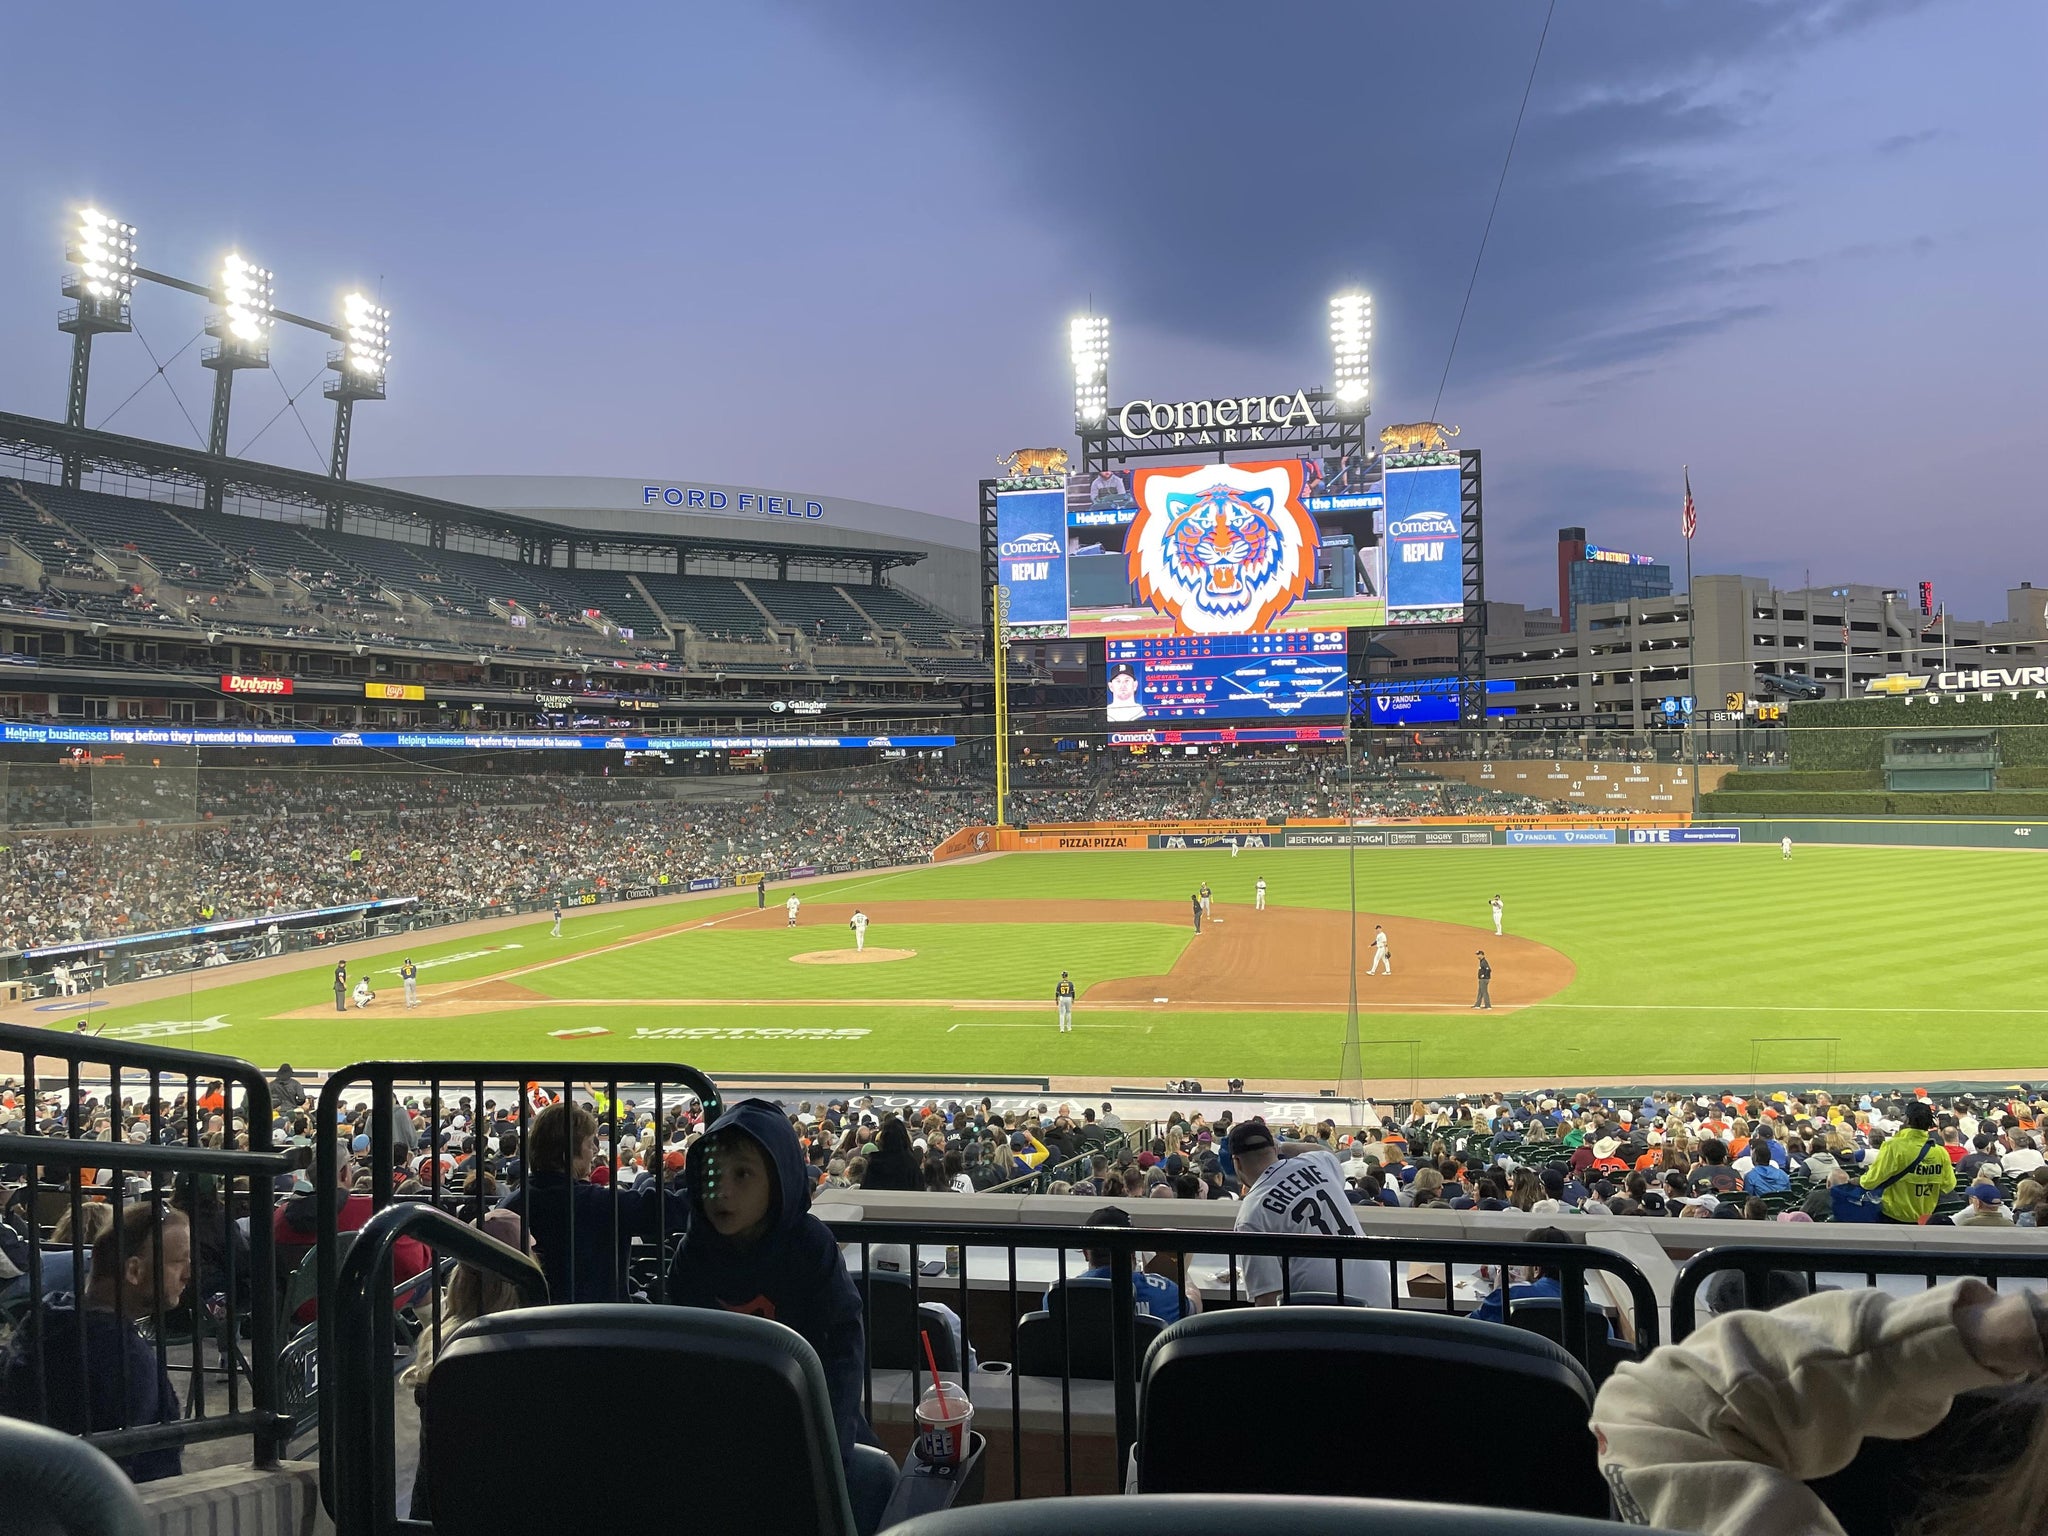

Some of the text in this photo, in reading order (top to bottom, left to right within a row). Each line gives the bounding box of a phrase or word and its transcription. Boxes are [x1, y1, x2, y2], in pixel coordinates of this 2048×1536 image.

[1173, 426, 1265, 446] PARK
[643, 485, 824, 520] FORD FIELD
[1312, 499, 1331, 509] the
[1075, 510, 1117, 525] Helping
[1403, 542, 1444, 562] REPLAY
[1011, 562, 1049, 581] REPLAY
[230, 676, 284, 690] Dunham's
[386, 685, 404, 697] Lay's
[535, 693, 573, 704] CHAMPIONS
[788, 700, 827, 710] Gallagher
[5, 728, 296, 744] Helping businesses long before they invented the homerun.
[398, 735, 426, 747] Helping
[427, 735, 464, 745] businesses
[465, 736, 480, 747] long
[480, 736, 501, 746] before
[502, 736, 516, 748] they
[518, 736, 543, 746] invented
[544, 737, 554, 746] the
[648, 738, 840, 749] Helping businesses long before they invented the homerun.
[1483, 764, 1491, 772] 23
[1593, 765, 1599, 773] 2
[1633, 766, 1641, 774] 16
[1677, 768, 1682, 776] 6
[1572, 781, 1581, 789] 47
[1613, 783, 1619, 791] 3
[1634, 830, 1670, 842] DTE
[2013, 827, 2031, 836] 412'
[1059, 837, 1127, 848] PIZZA! PIZZA!
[1296, 836, 1333, 844] BETMGM
[568, 894, 596, 906] bet365
[635, 1027, 873, 1036] VICTORS
[1262, 1165, 1329, 1215] GREENE
[1291, 1189, 1356, 1236] 31
